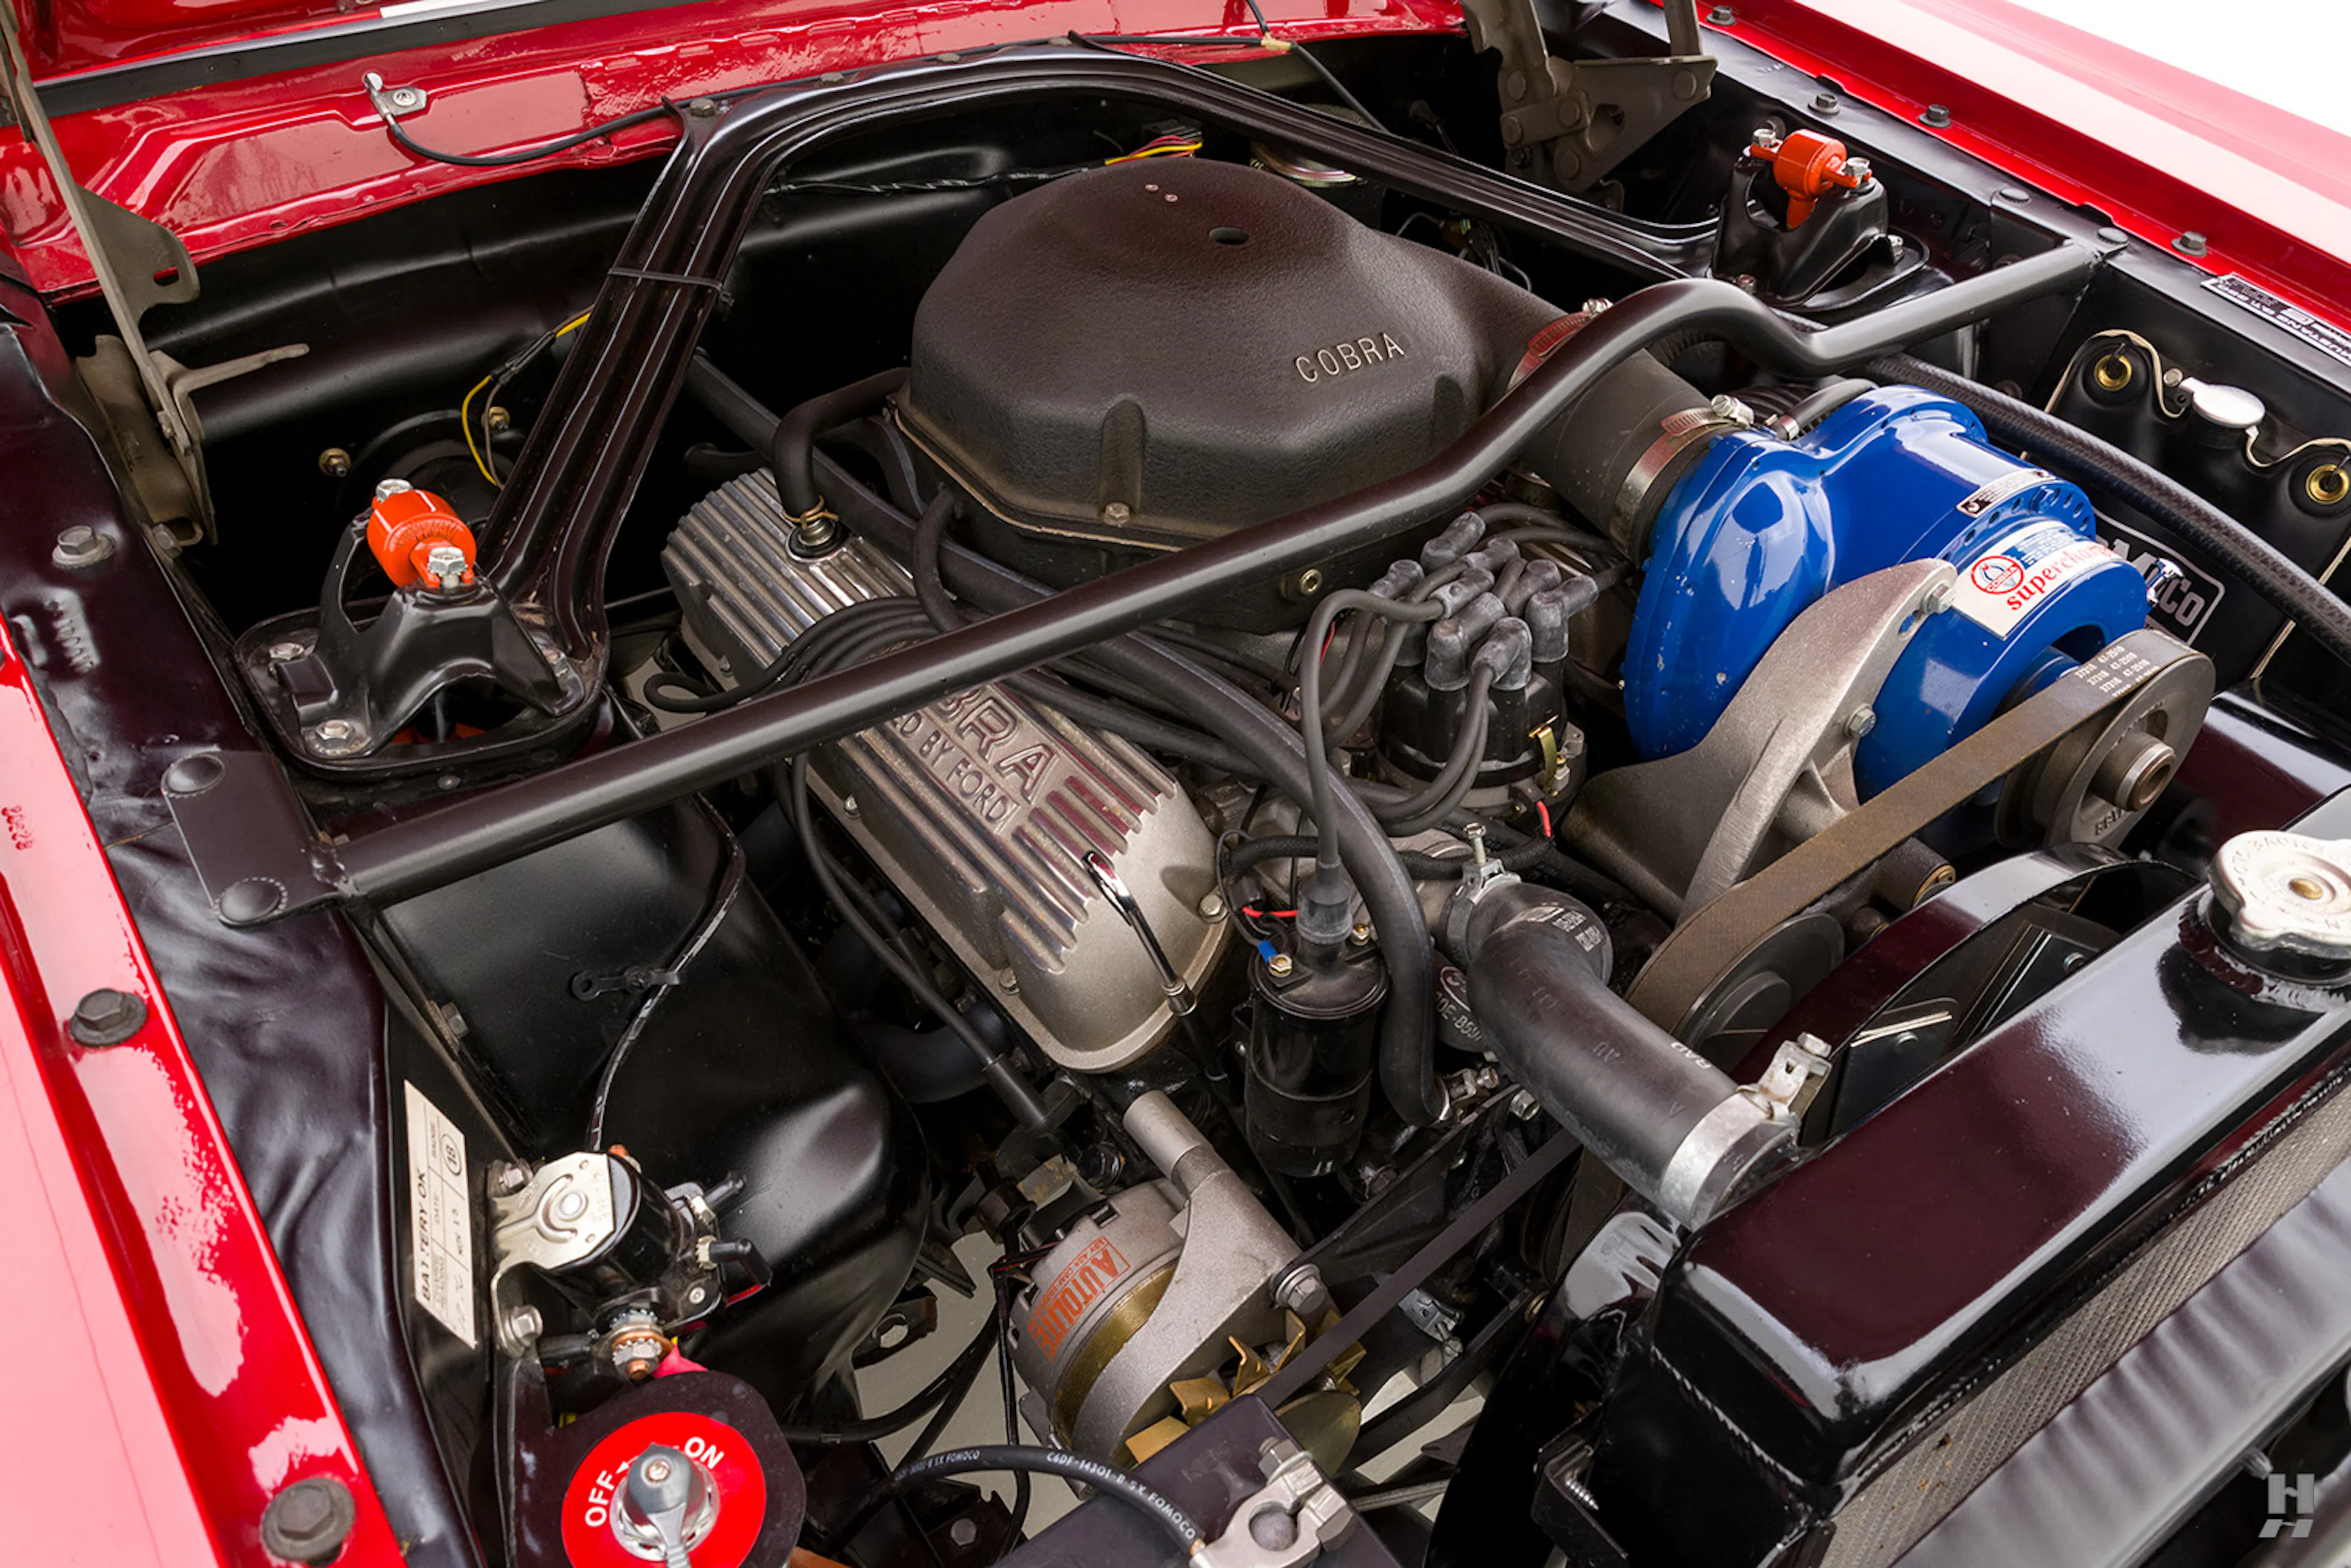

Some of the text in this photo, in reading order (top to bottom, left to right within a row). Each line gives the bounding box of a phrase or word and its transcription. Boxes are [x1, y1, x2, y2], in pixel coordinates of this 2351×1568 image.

[1295, 332, 1404, 383] COBRA
[919, 730, 1010, 822] BY FORD
[1671, 1041, 1712, 1070] RAD
[445, 1144, 457, 1164] 18
[418, 1168, 427, 1198] OK
[1036, 1248, 1119, 1359] AUTOLITE
[684, 1436, 724, 1469] ON
[585, 1470, 615, 1527] OFF
[1148, 1491, 1197, 1541] FOMOCO
